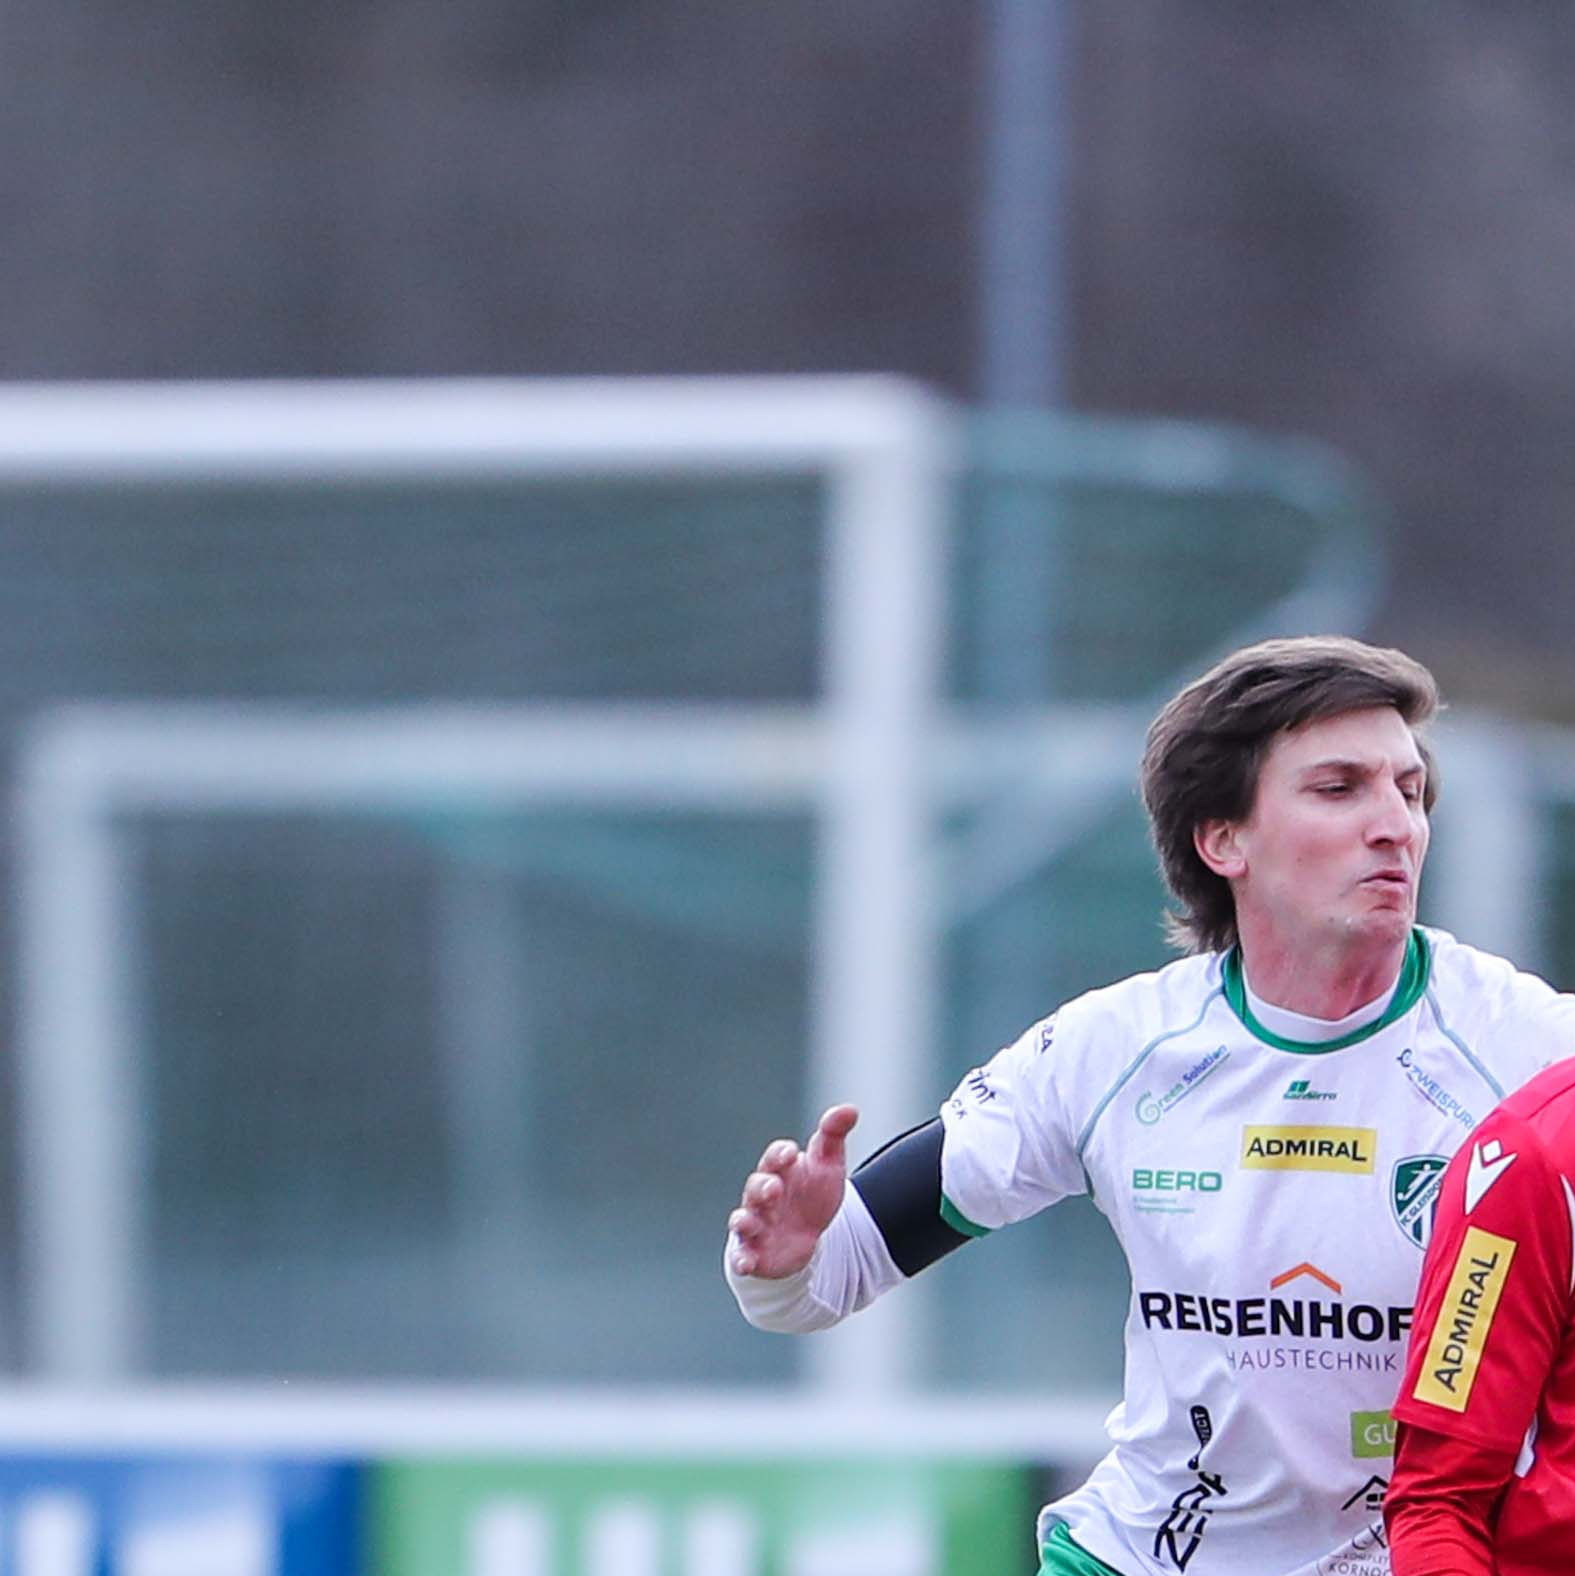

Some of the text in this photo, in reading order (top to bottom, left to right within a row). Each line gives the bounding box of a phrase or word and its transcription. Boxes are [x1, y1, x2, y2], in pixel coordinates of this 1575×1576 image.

[1246, 1136, 1367, 1163] ADMIRAL
[1133, 1169, 1222, 1192] BERO
[1139, 1291, 1415, 1342] REISENHOF
[1434, 1252, 1499, 1394] ADMIRAL
[1226, 1348, 1398, 1372] HAUSTECHNIK
